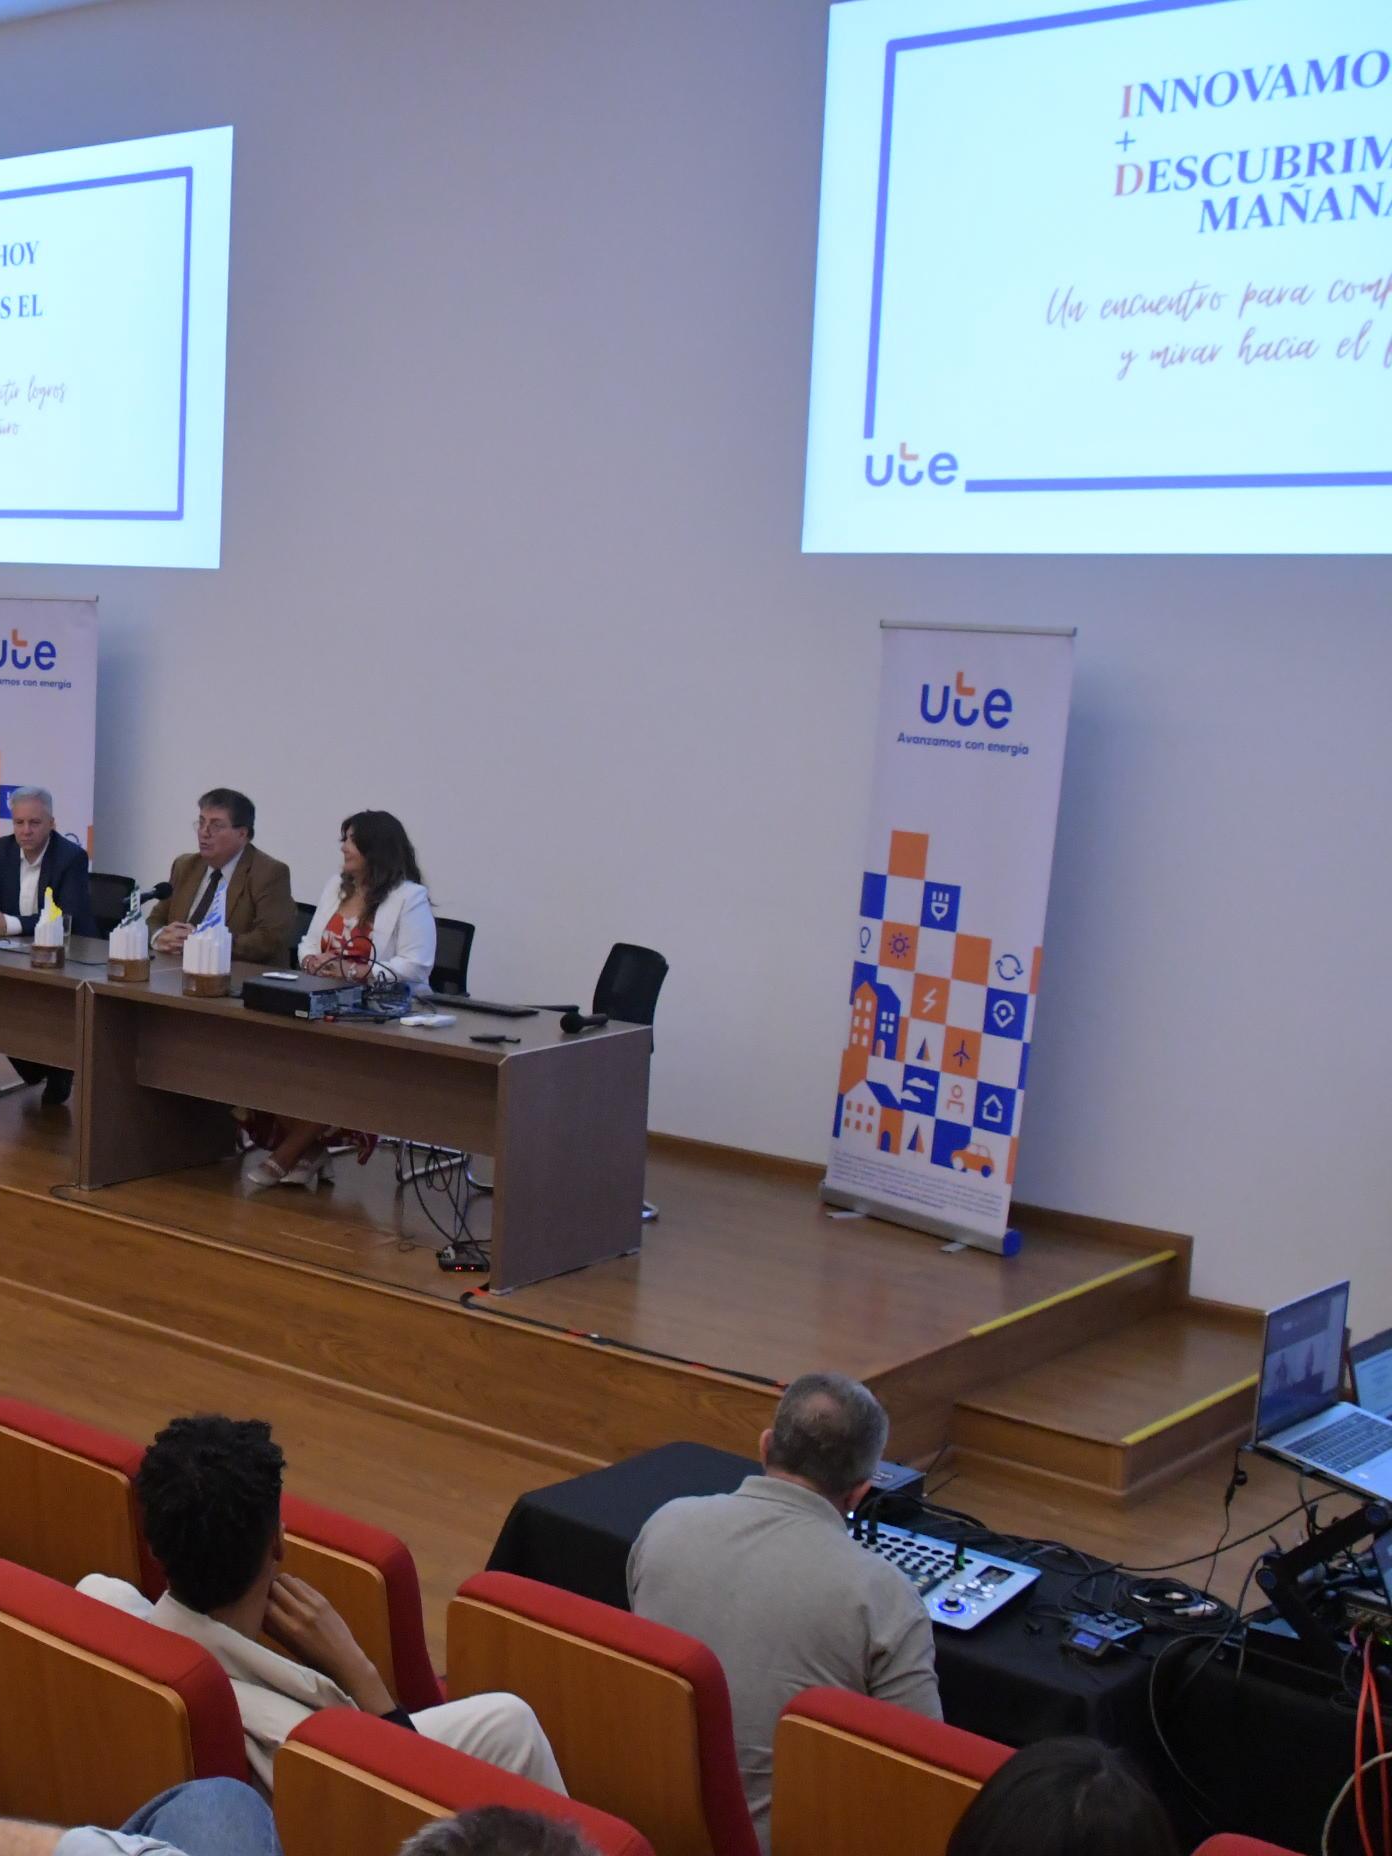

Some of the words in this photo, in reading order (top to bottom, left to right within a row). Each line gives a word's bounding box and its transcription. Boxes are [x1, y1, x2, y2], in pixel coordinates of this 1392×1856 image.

[1115, 130, 1136, 152] +
[1198, 182, 1392, 233] MAÑAN
[17, 294, 44, 318] EL
[1046, 285, 1087, 328] Un
[1100, 280, 1226, 321] encuentro
[1238, 281, 1313, 319] para
[1117, 348, 1138, 380] y
[1149, 344, 1223, 368] mirar
[1237, 326, 1319, 365] hacia
[1336, 319, 1373, 361] el
[863, 441, 959, 488] ute
[22, 679, 38, 688] con
[920, 671, 1013, 729] ute
[897, 732, 962, 749] Avanzamos
[964, 739, 985, 751] con
[987, 741, 1029, 757] energía
